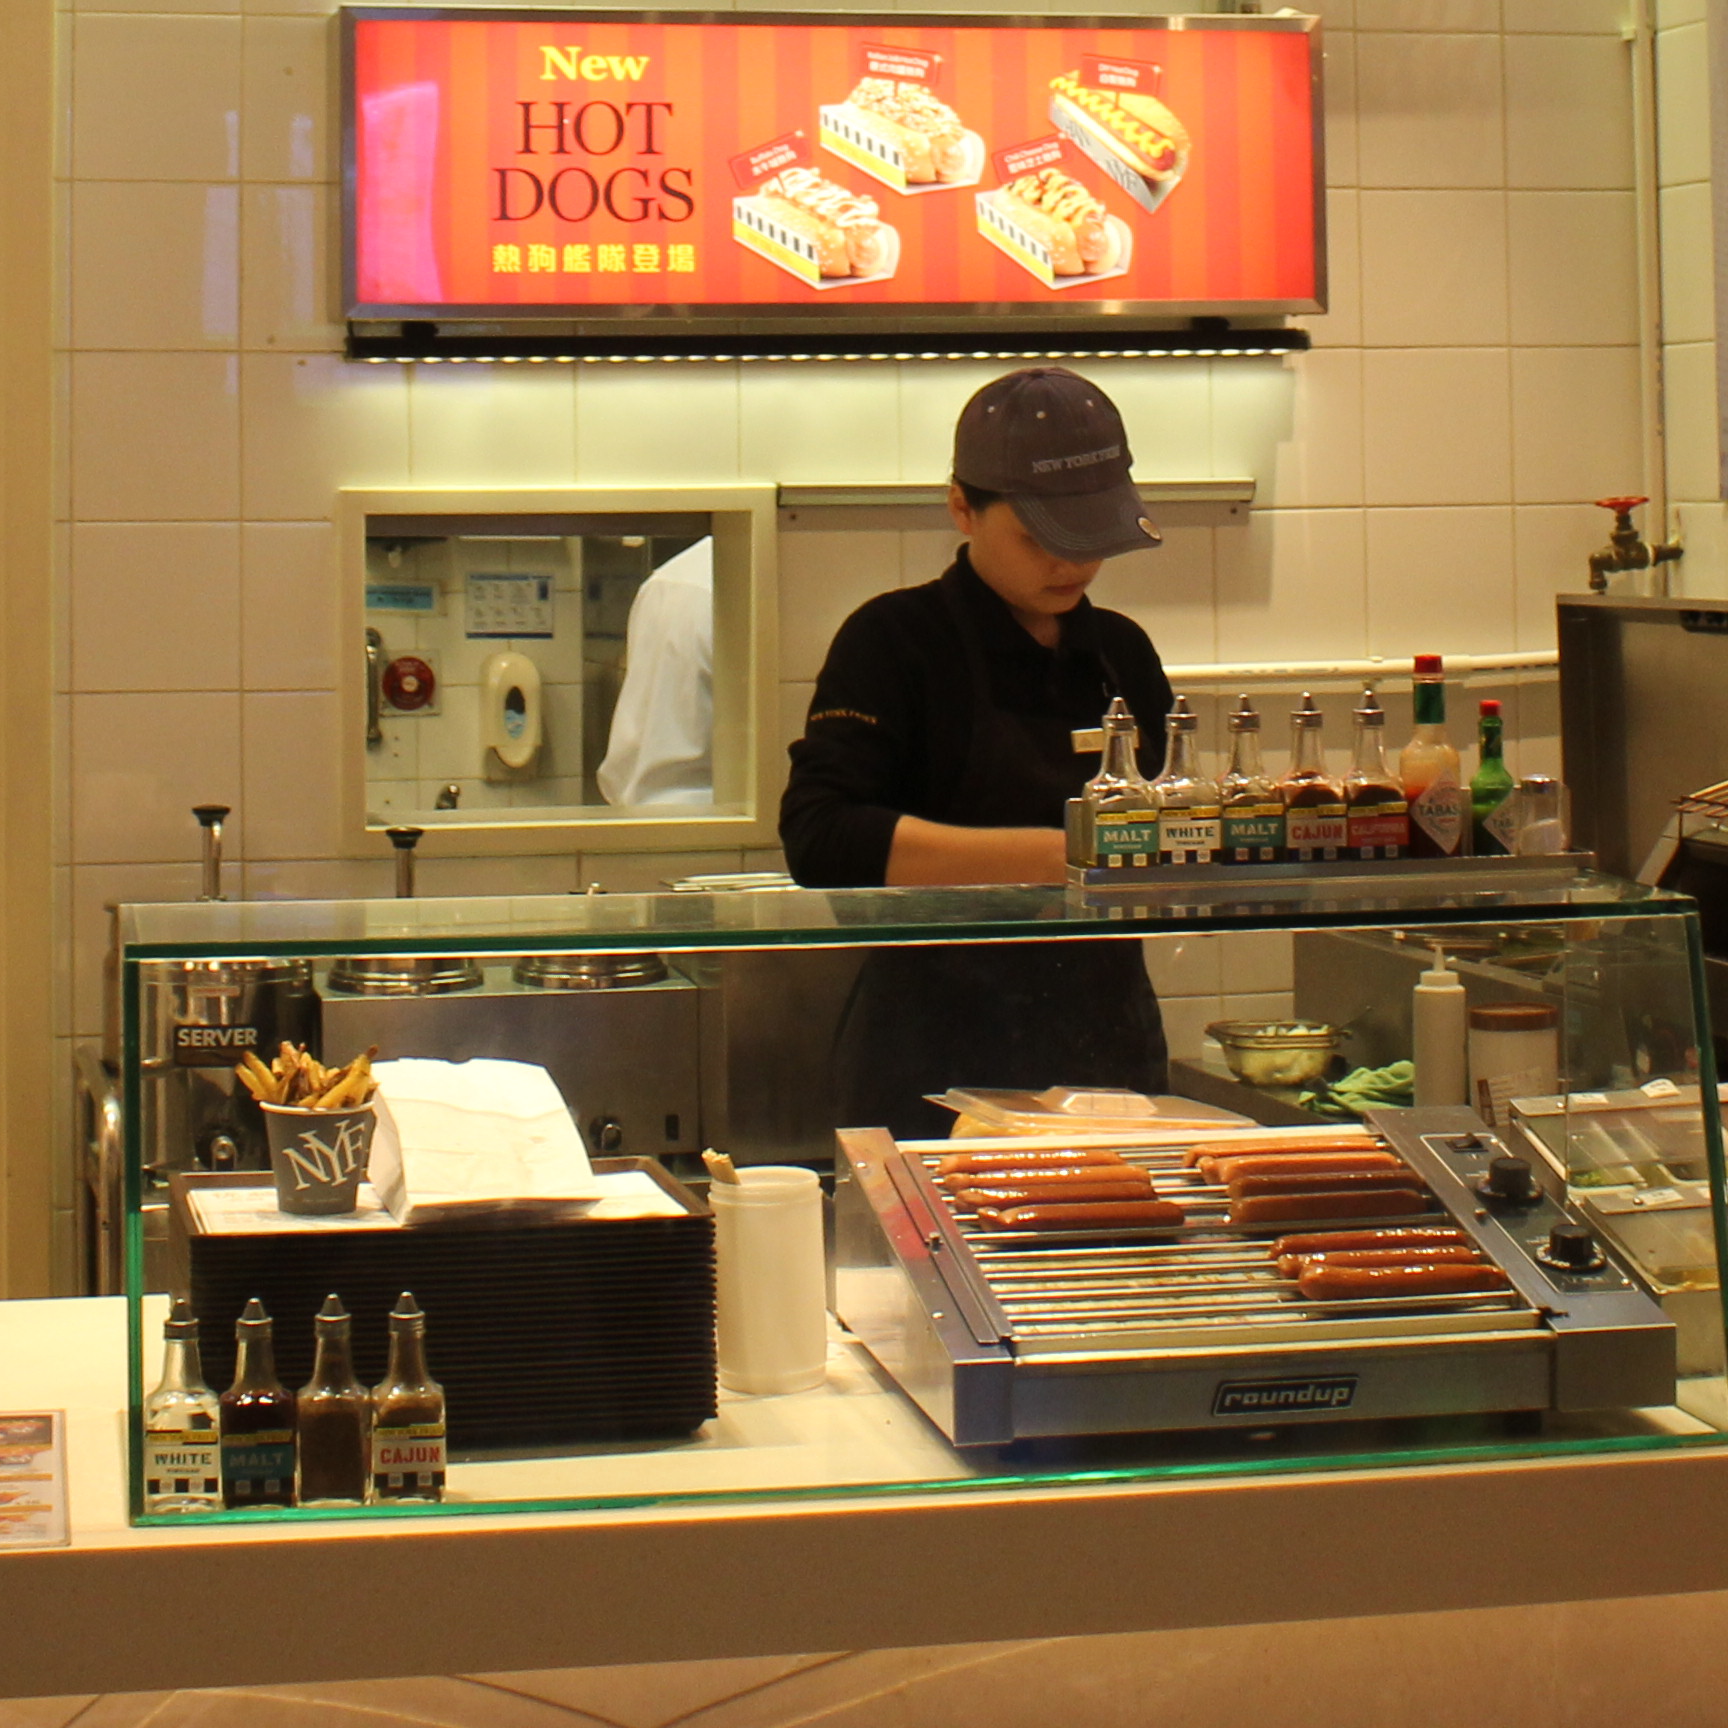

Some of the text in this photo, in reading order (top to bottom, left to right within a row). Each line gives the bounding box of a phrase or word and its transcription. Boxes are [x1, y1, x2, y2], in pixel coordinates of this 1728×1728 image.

[538, 45, 650, 83] New
[515, 99, 674, 158] HOT
[491, 164, 696, 224] DOGS
[492, 243, 696, 274] 熱狗艦隊登場
[1103, 829, 1152, 843] MALT
[1165, 826, 1215, 839] WHITE
[1230, 823, 1279, 836] MALT
[1291, 821, 1344, 840] CAJUN
[177, 1027, 258, 1048] SERVER
[282, 1119, 366, 1191] NYF
[1224, 1383, 1350, 1410] roundup
[154, 1452, 213, 1466] WHITE
[228, 1451, 284, 1467] MALT
[380, 1446, 442, 1465] CAJUN
